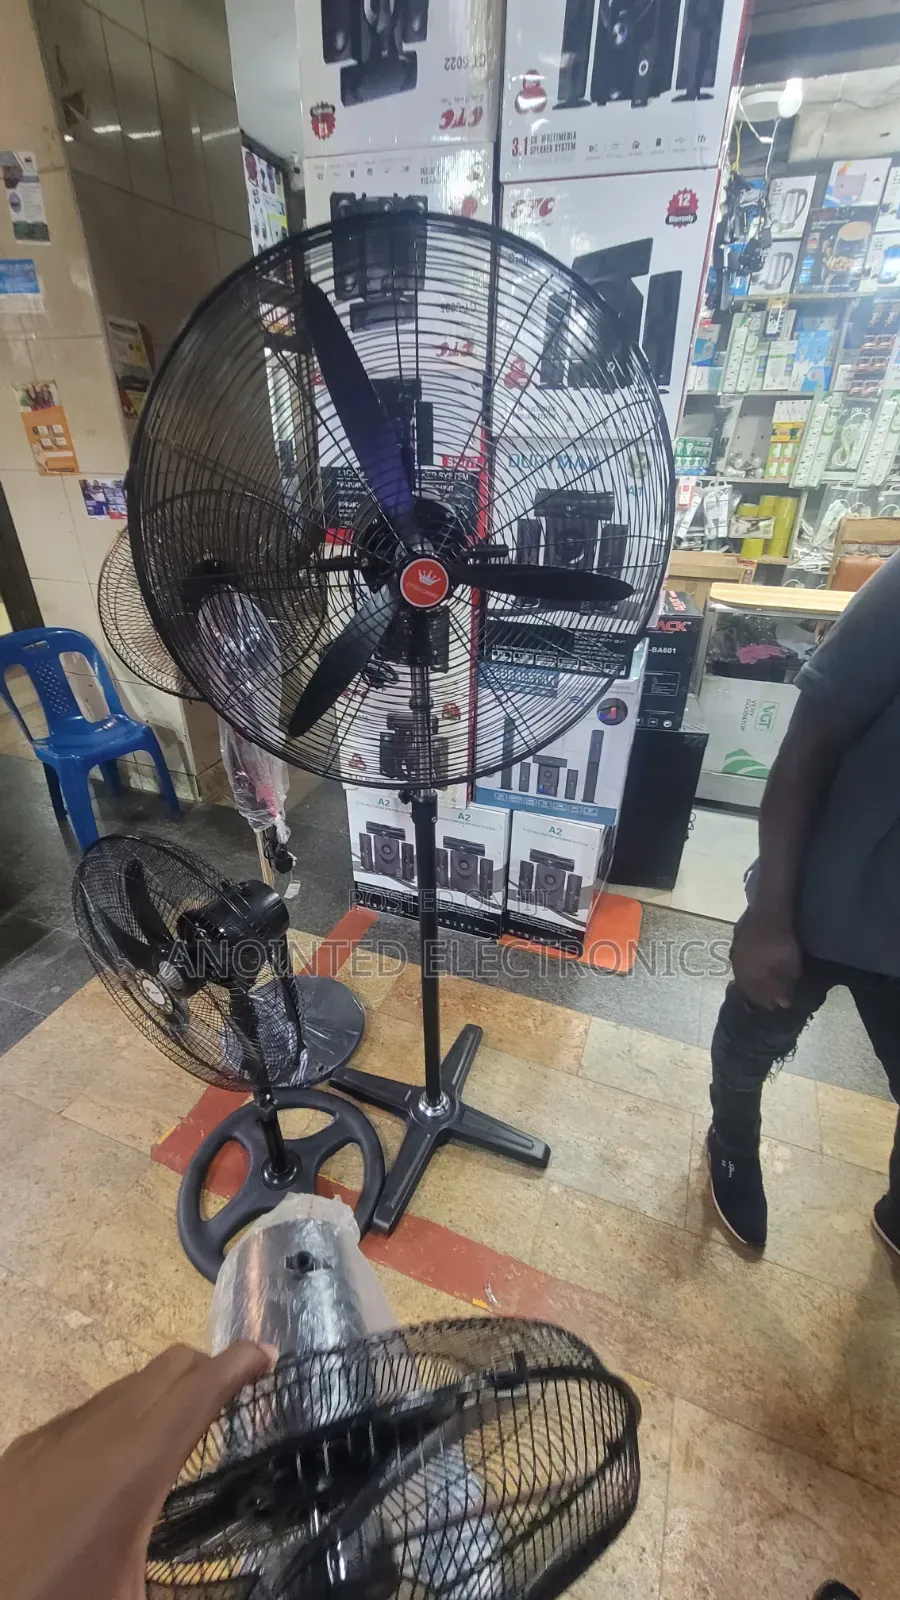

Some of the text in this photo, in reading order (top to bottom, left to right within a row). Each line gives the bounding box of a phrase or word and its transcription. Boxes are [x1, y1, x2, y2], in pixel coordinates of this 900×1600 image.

[512, 136, 528, 157] 3.1
[541, 131, 577, 143] MULTIMEDIA
[530, 141, 577, 156] SPEAKER SYSTEM
[678, 192, 691, 207] 12
[669, 214, 694, 224] Warranty
[749, 699, 757, 718] VERY
[759, 705, 776, 730] VGT
[378, 798, 391, 807] A2
[457, 812, 471, 822] A2
[548, 826, 563, 836] A2
